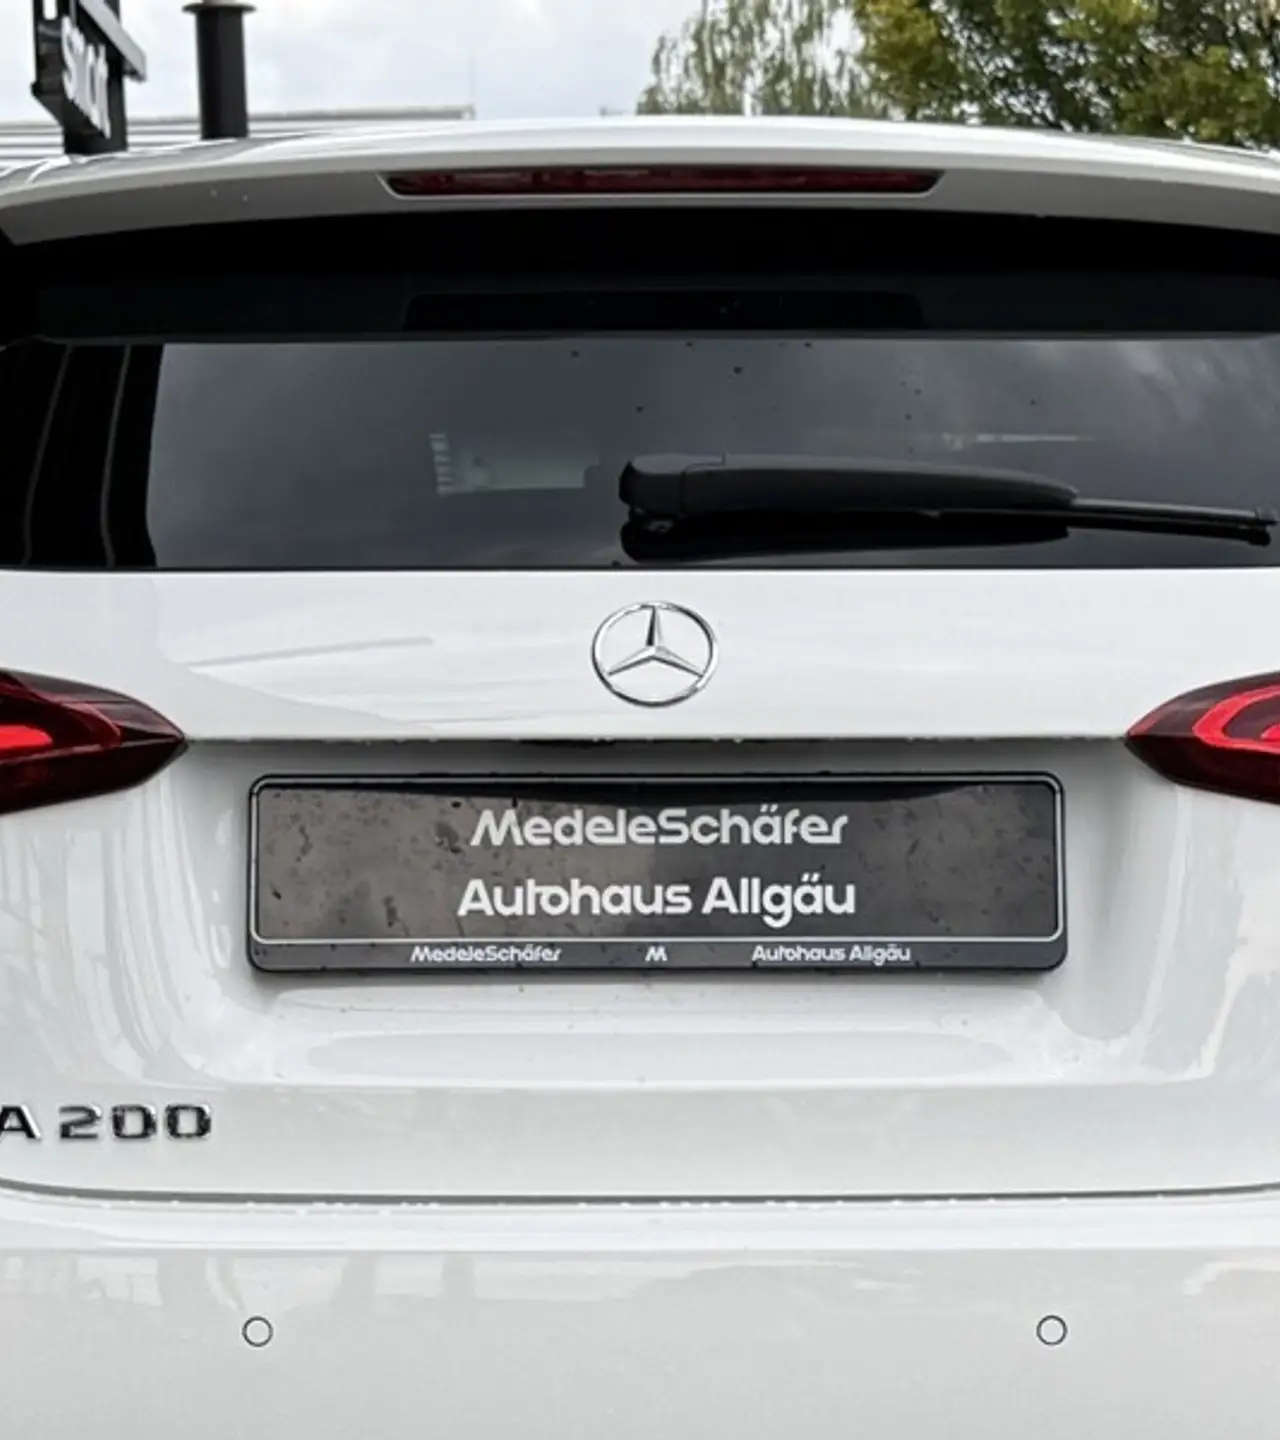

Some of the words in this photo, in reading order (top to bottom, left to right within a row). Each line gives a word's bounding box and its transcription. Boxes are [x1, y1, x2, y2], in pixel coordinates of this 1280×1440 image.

[469, 803, 849, 847] MedeleSchäfer
[457, 878, 693, 918] Autohaus
[701, 873, 856, 928] Allgäu
[410, 942, 563, 964] MedeleSchäfer
[751, 944, 847, 964] Autohaus
[848, 943, 912, 967] Allgäu
[59, 1104, 212, 1140] 200
